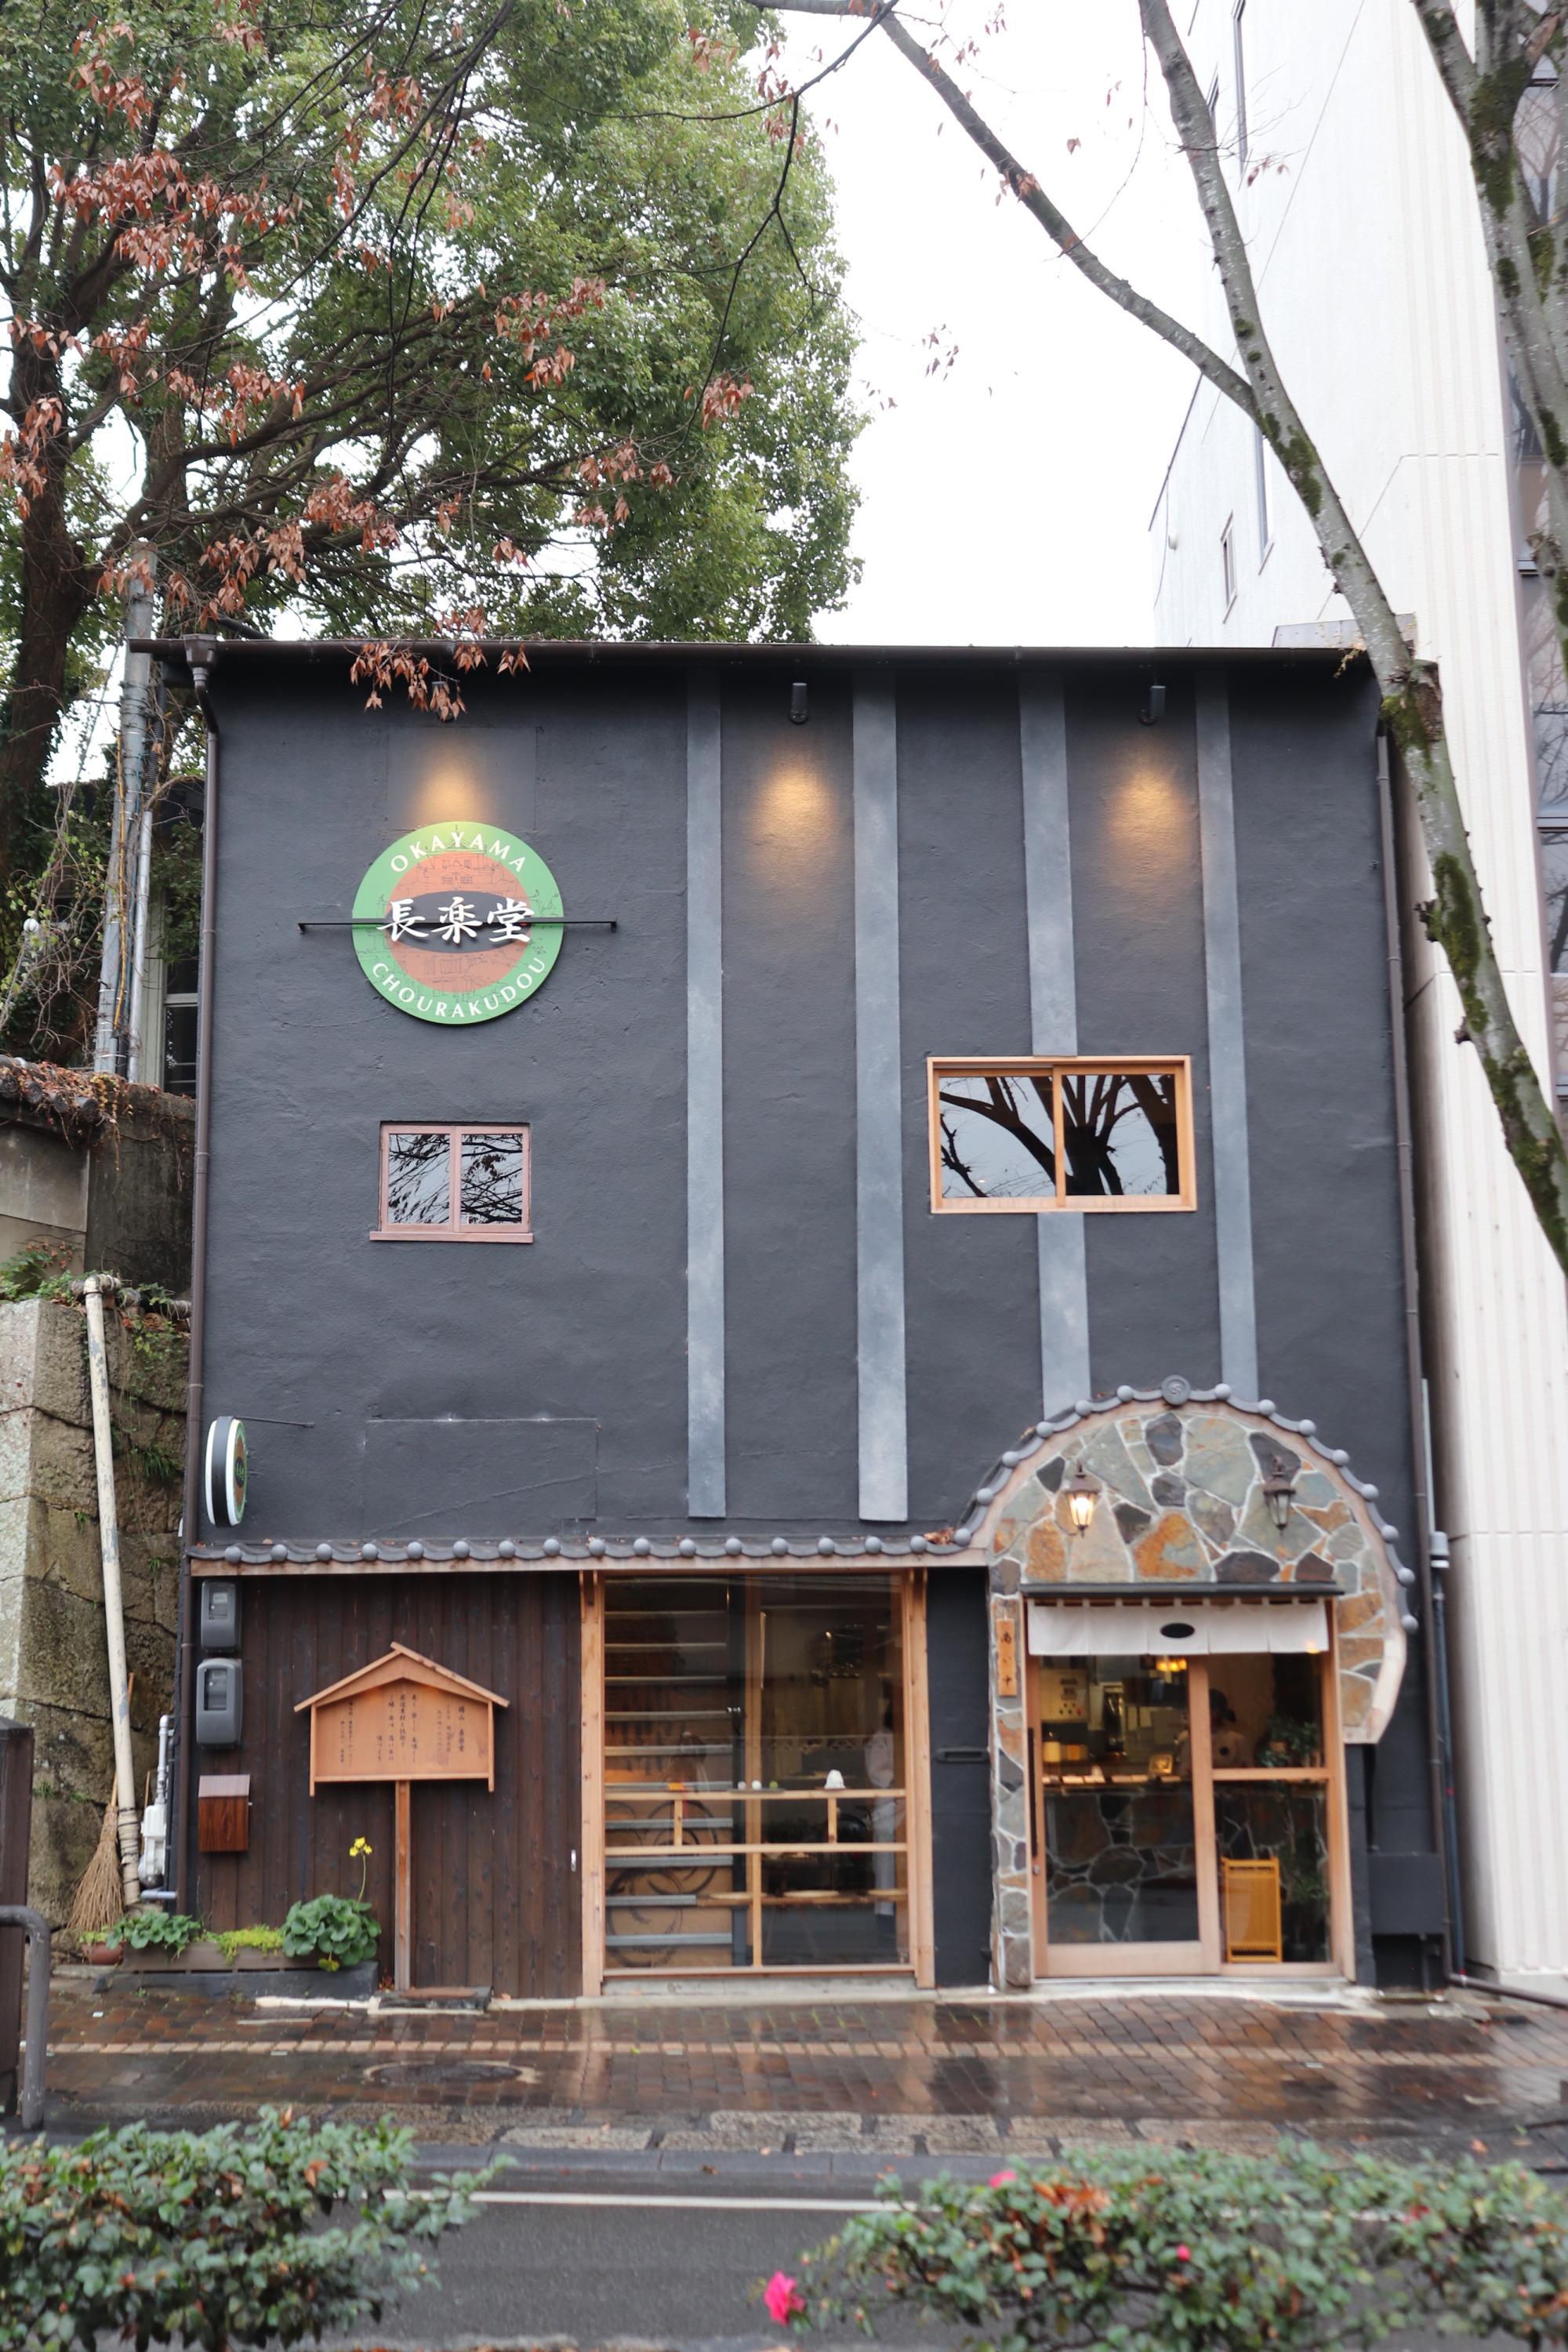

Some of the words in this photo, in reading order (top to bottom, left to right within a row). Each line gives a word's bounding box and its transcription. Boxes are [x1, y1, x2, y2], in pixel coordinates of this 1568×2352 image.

[390, 832, 526, 873] OKAYAMA
[376, 897, 535, 944] 長楽堂
[372, 956, 546, 1018] CHOURAKUDOU
